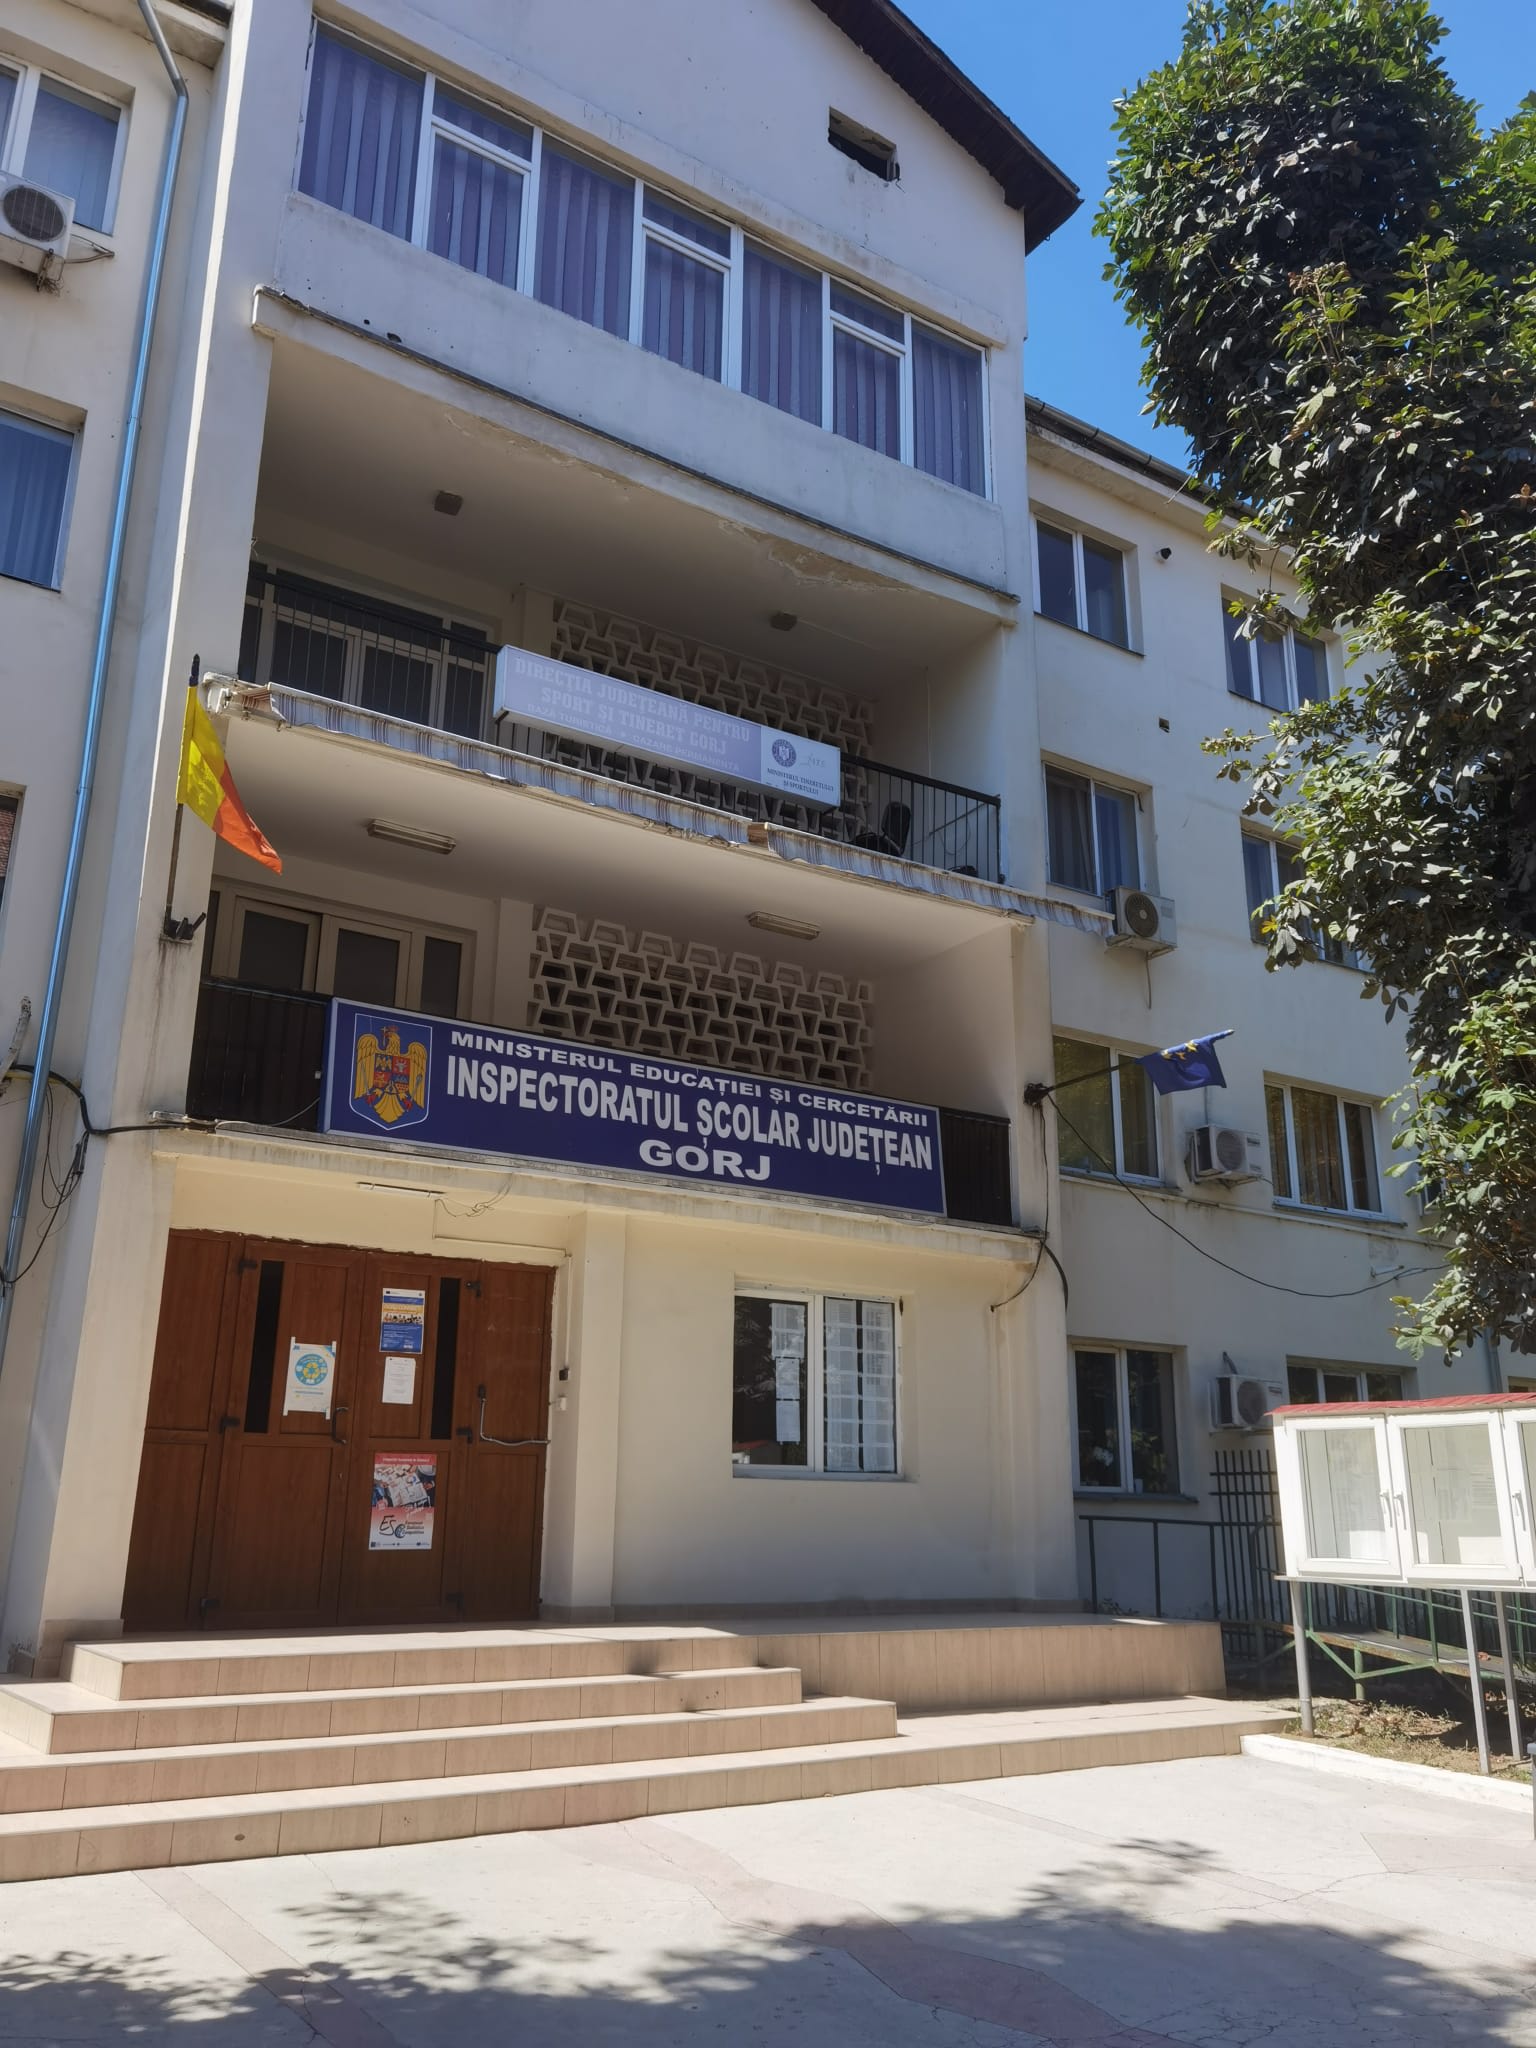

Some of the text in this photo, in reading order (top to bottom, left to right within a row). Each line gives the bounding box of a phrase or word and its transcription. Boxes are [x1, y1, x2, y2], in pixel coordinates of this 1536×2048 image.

[540, 685, 591, 716] SPORT
[618, 708, 685, 744] TINERET
[689, 729, 727, 756] GORJ
[693, 710, 750, 743] PENTRU
[451, 1031, 928, 1127] MINISTERUL EDUCAȚIEI ȘI CERCETĂRII
[447, 1055, 933, 1176] INSPECTORATUL ȘCOLAR JUDEȚEAN
[639, 1139, 771, 1181] GORJ
